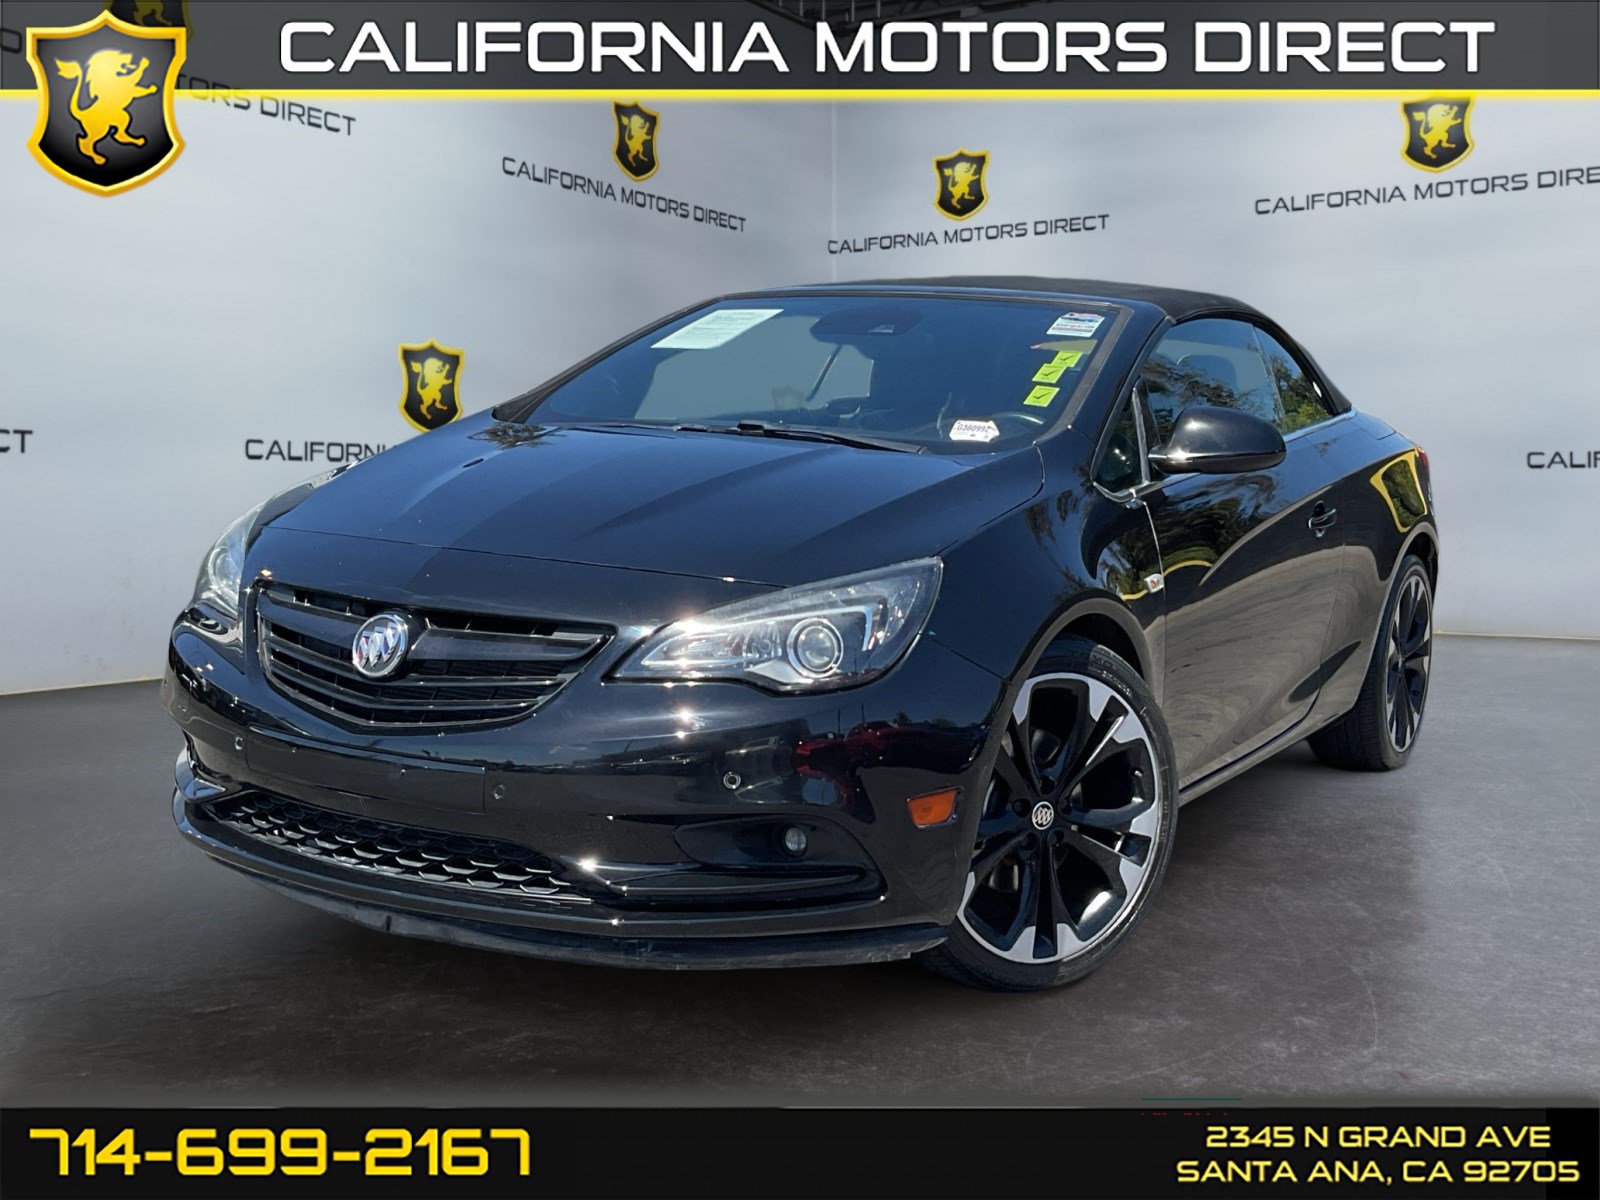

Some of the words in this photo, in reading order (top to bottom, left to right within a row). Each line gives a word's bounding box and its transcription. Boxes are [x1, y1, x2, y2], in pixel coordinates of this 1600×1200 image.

[176, 73, 251, 110] TORS
[259, 94, 357, 136] DIRECT
[502, 156, 617, 201] CALIFORNIA
[620, 187, 690, 218] MOTORS
[692, 205, 747, 232] DIRECT
[1254, 185, 1406, 215] CALIFORNIA
[1413, 173, 1529, 201] MOTORS
[827, 231, 938, 255] CALIFORNIA
[943, 222, 1028, 245] MOTORS
[1033, 214, 1110, 237] DIRECT
